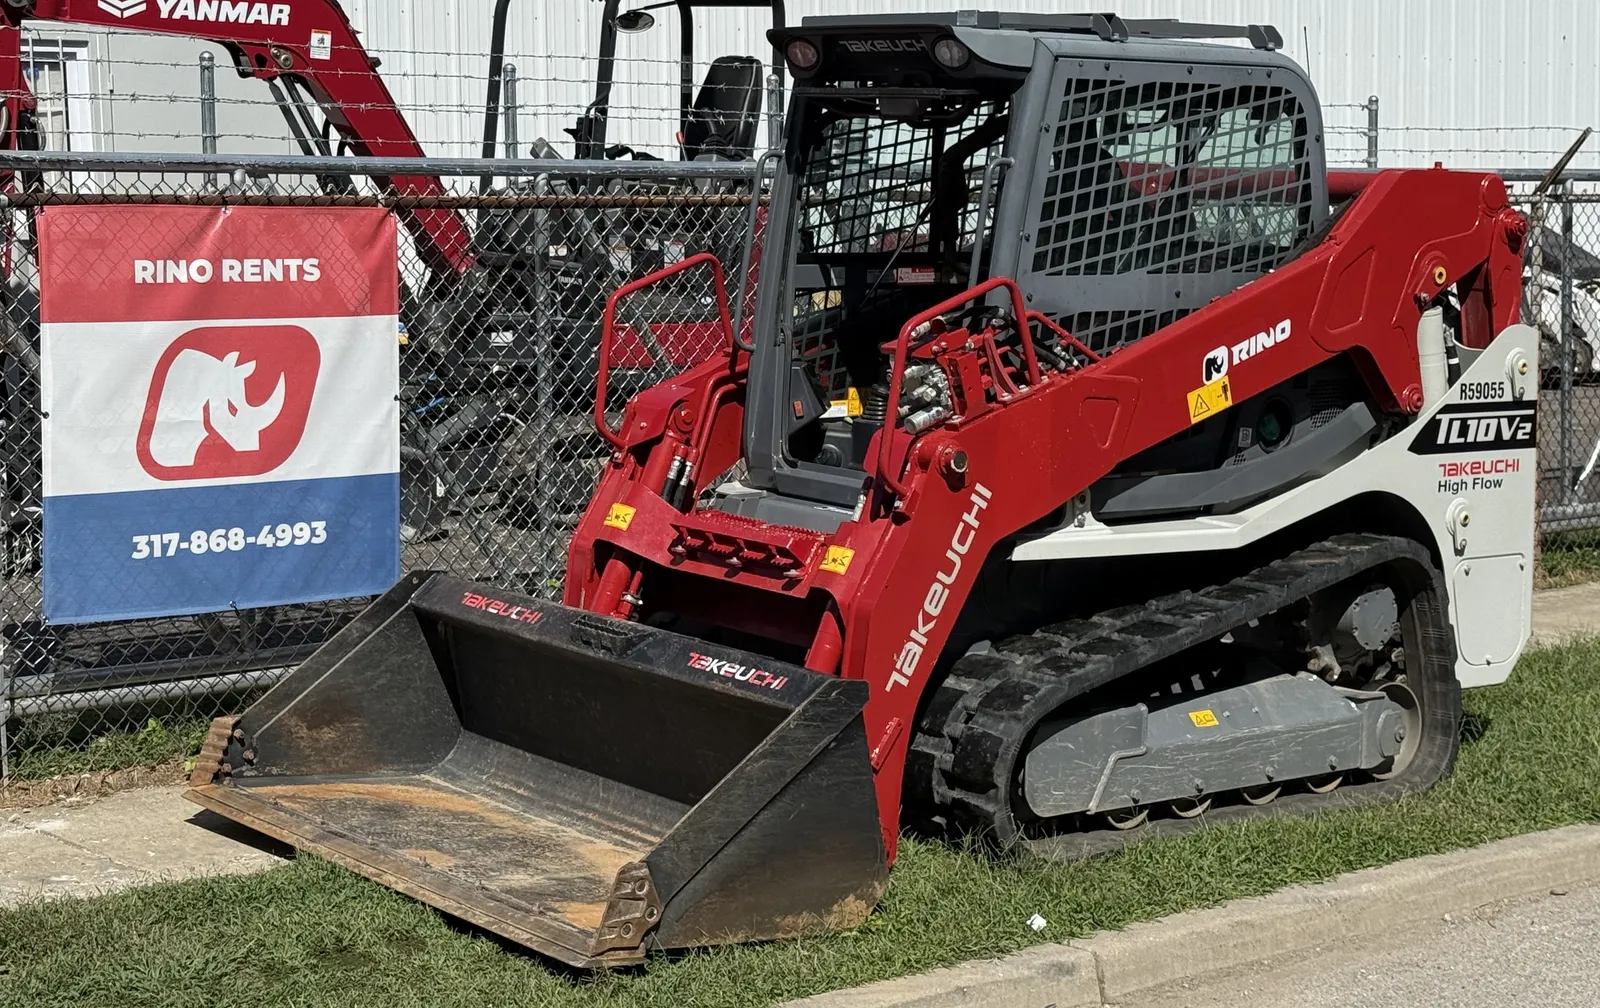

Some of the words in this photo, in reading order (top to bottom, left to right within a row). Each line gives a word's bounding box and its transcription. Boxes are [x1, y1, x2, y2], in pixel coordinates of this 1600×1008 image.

[158, 0, 291, 26] YANMAR
[838, 39, 929, 53] TAKEUCH
[134, 259, 214, 284] RINO
[222, 258, 321, 283] RENTS
[1230, 318, 1292, 367] RINO
[1460, 382, 1505, 400] R59055
[1435, 409, 1535, 445] TL10V2
[1438, 458, 1520, 477] TAKEUCHI
[1438, 478, 1468, 495] High
[1472, 477, 1503, 493] Flow
[131, 521, 327, 560] 317-868-4993
[885, 482, 993, 693] TAKEUCHI
[461, 591, 544, 624] TAKEUCHI
[687, 651, 790, 691] TAKEUCHI
